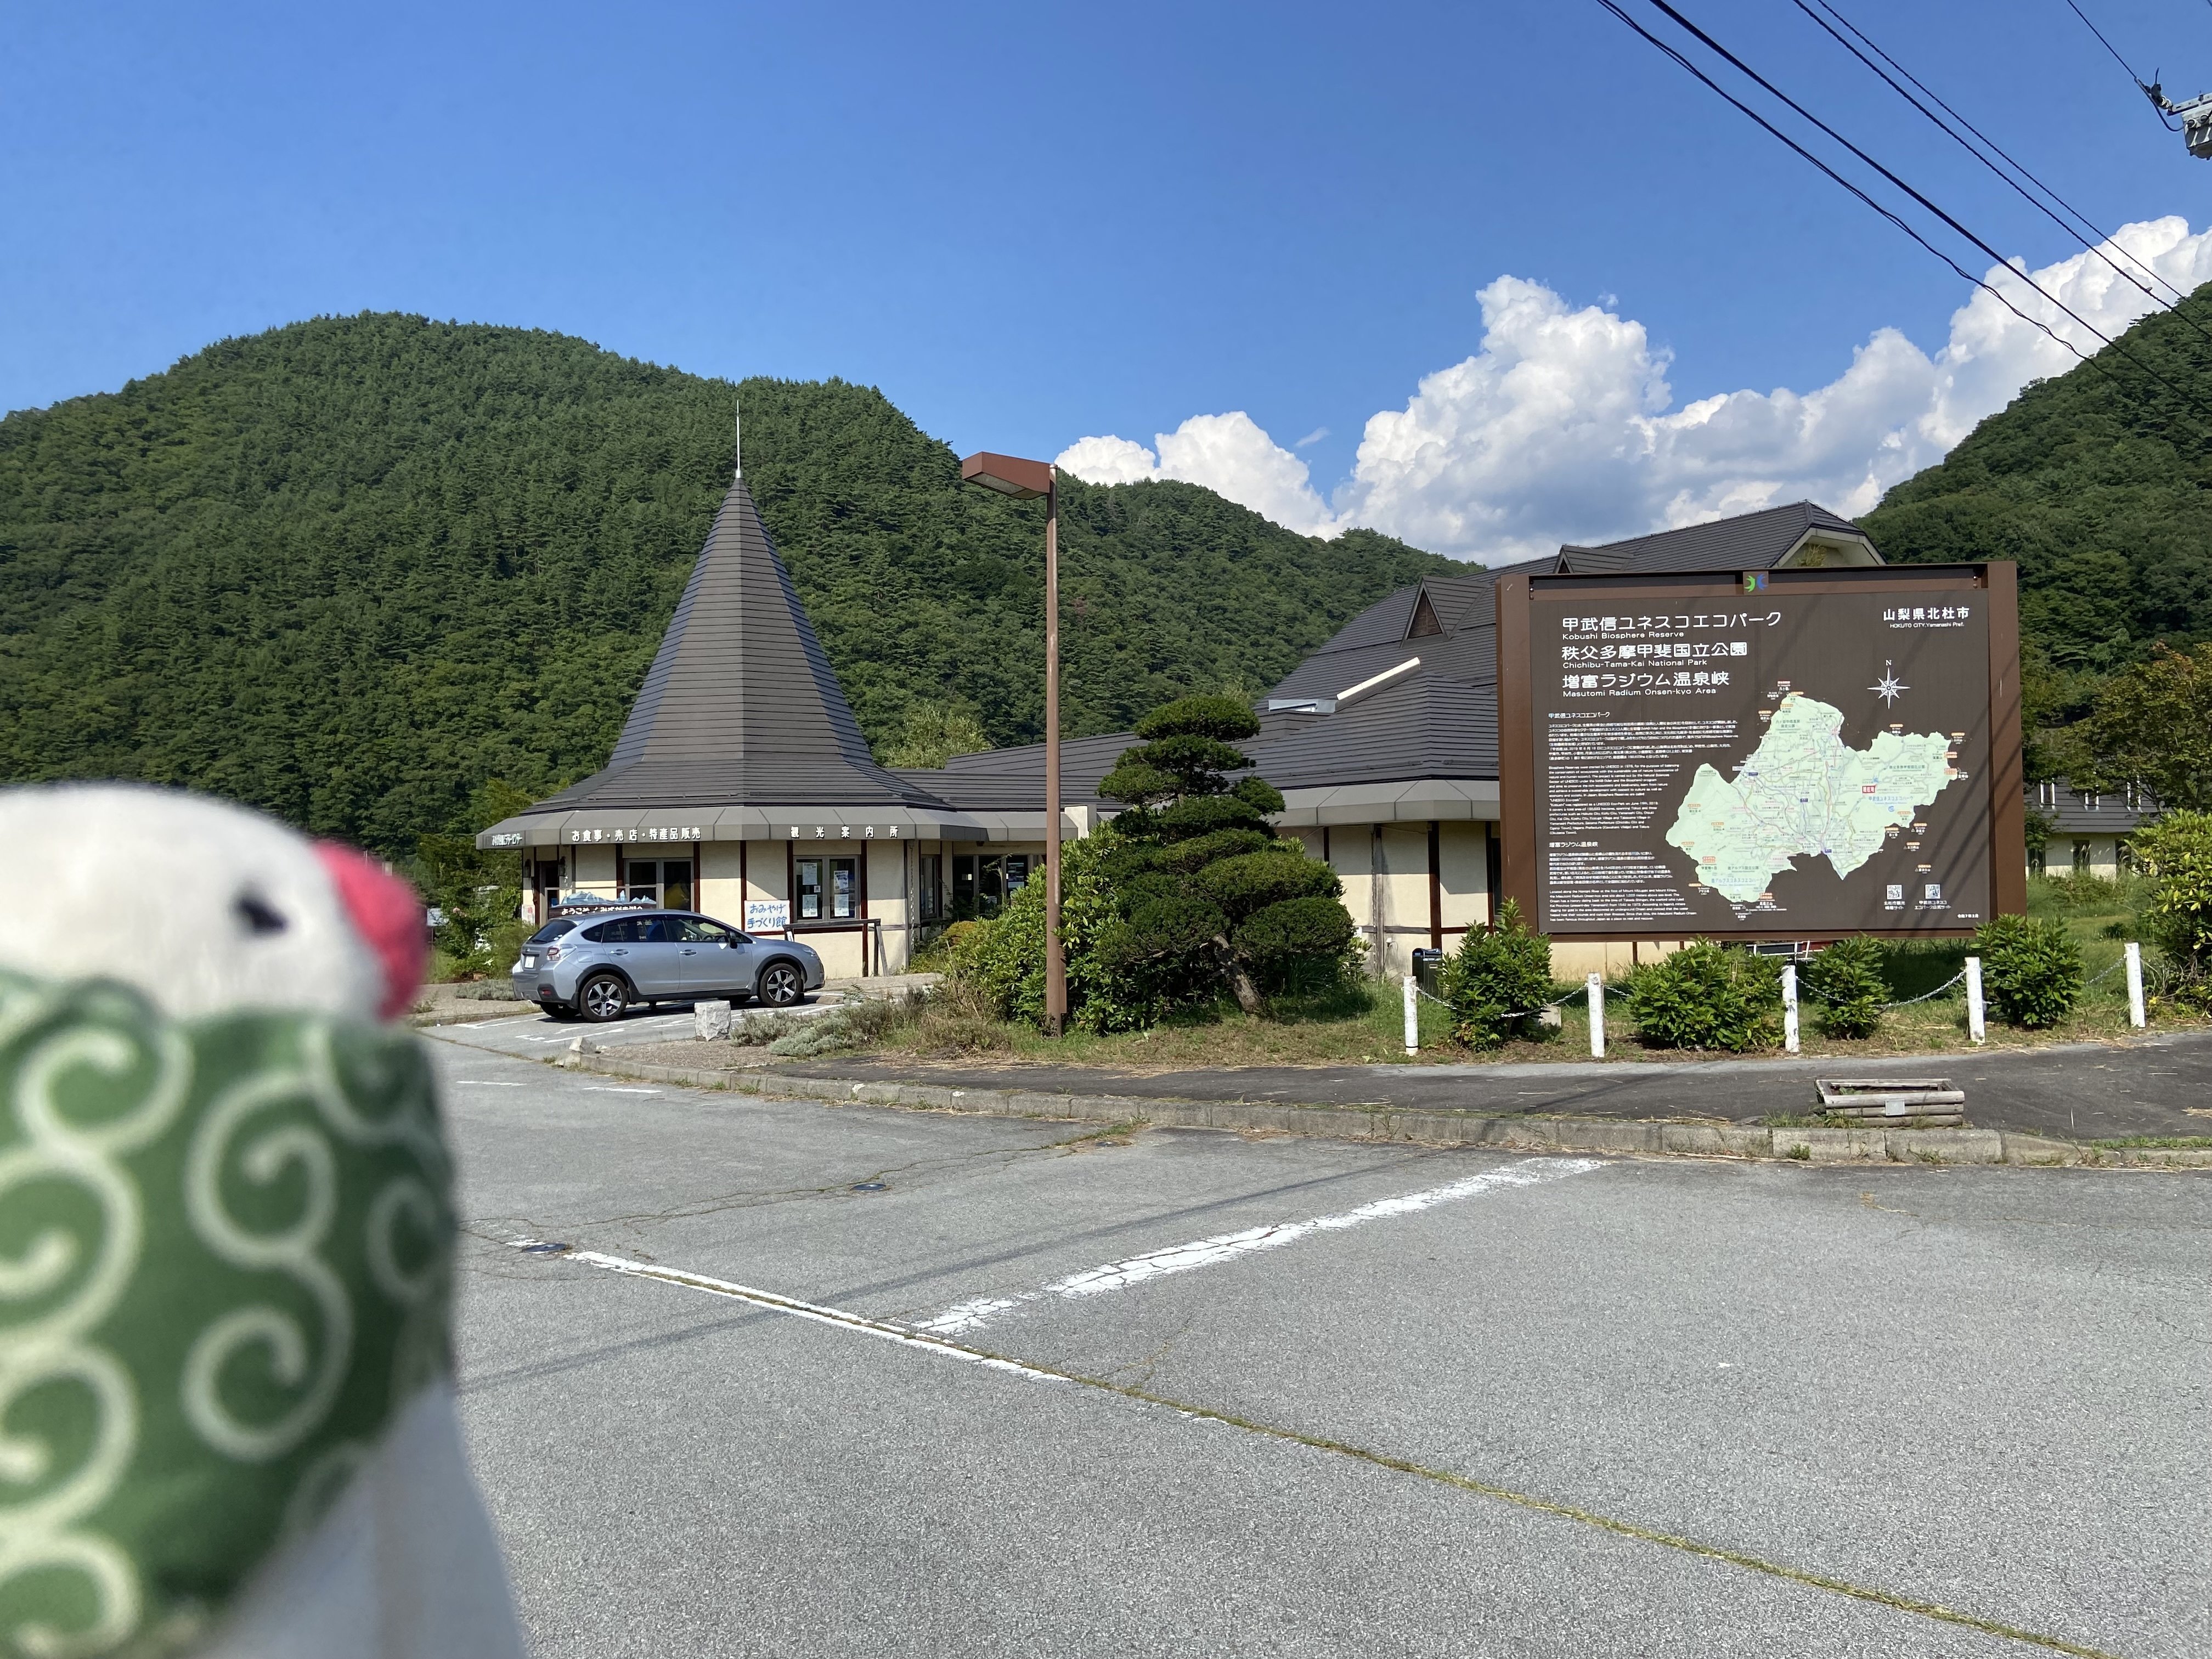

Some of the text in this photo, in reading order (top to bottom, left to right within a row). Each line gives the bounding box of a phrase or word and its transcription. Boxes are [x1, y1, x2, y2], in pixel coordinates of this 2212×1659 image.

[1883, 607, 1970, 621] 山梨県北杜市
[1562, 612, 1781, 631] 甲武信ユネスコエコパーク
[1562, 642, 1747, 660] 秩父多摩甲斐国立公園
[1562, 671, 1730, 689] 増富ラジウム温泉峡
[572, 827, 701, 842] お食事・売店・特産品販売
[791, 826, 898, 838] 観光案内所
[750, 904, 786, 914] おみやげ
[747, 916, 787, 928] 手づくり館
